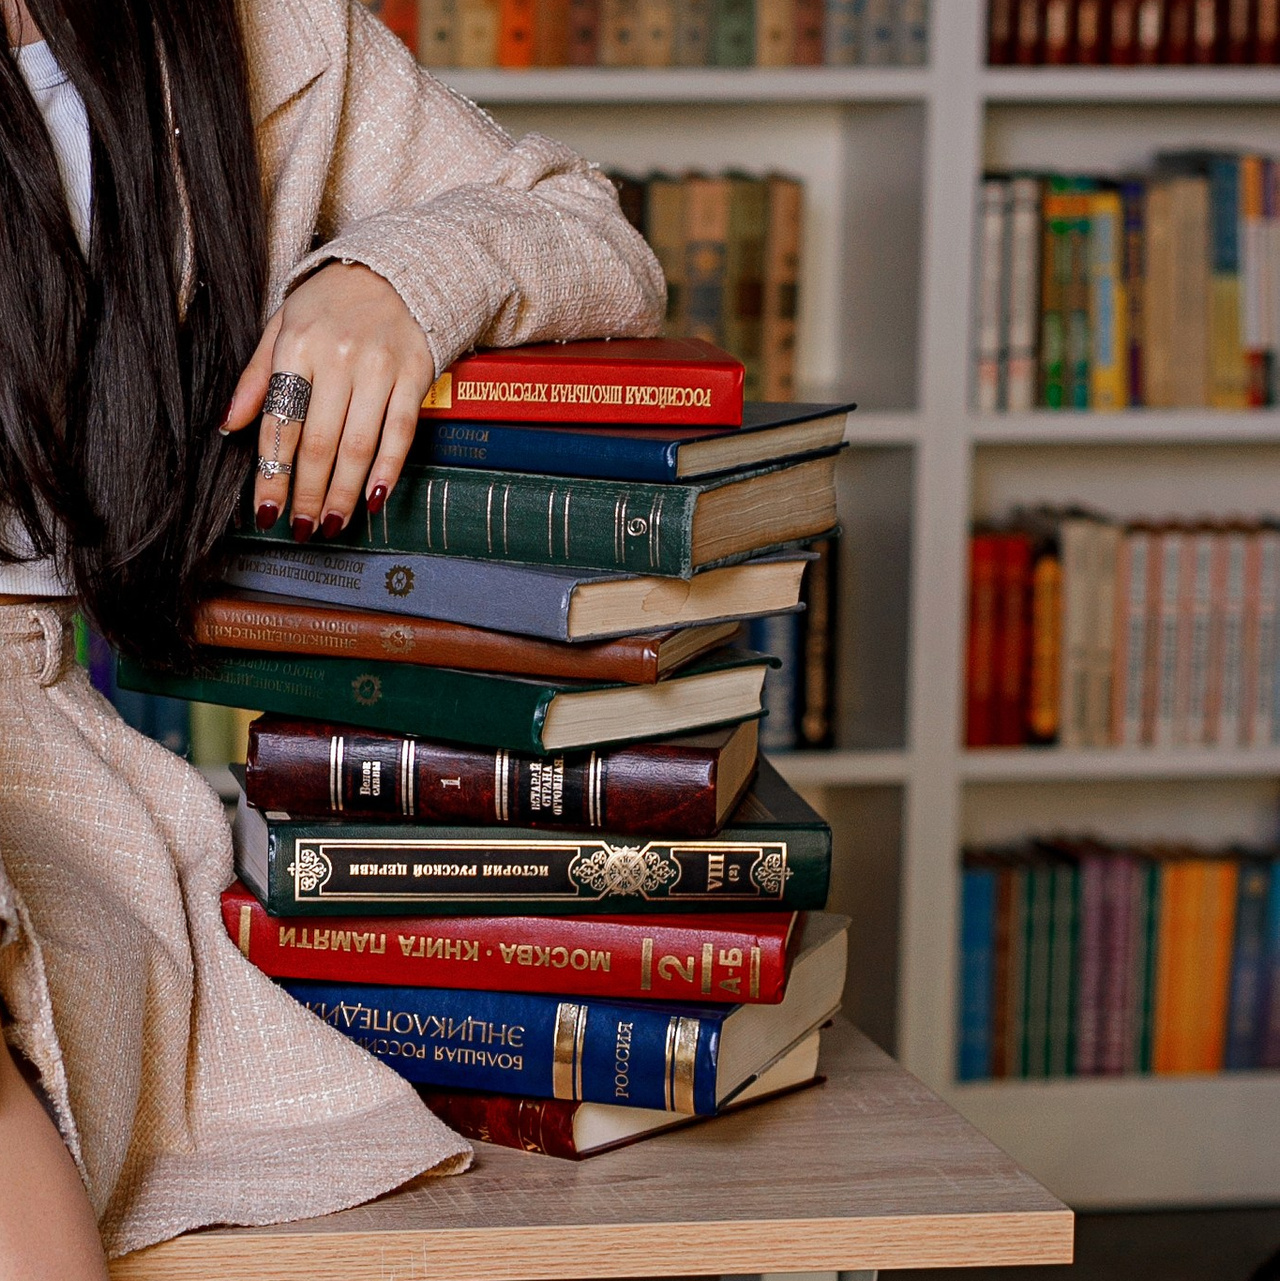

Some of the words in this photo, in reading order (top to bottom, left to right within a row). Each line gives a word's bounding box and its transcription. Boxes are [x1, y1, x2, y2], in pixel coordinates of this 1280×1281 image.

[457, 380, 549, 404] ХРЕСТОМАТИЯ
[550, 383, 623, 406] ШКОЛЬНАЯ
[625, 384, 712, 409] РОССИЙСКАЯ
[437, 426, 490, 442] ЮНОГО
[324, 556, 366, 575] ЮНОГО
[310, 619, 360, 635] ЮНОГО
[440, 776, 462, 790] 1
[542, 764, 553, 807] СТРАНА
[348, 862, 408, 877] ЦЕРКВИ
[412, 863, 478, 879] РУССКОЙ
[482, 863, 550, 878] ИСТОРИЯ
[707, 853, 725, 892] VIII
[728, 863, 741, 883] (2)
[277, 925, 387, 956] ПАМЯТИ
[398, 934, 480, 963] КНИГА
[499, 941, 612, 972] МОСКВА
[658, 954, 695, 983] 2
[433, 1044, 524, 1071] БОЛЬШАЯ
[614, 1021, 634, 1099] РОССИЯ
